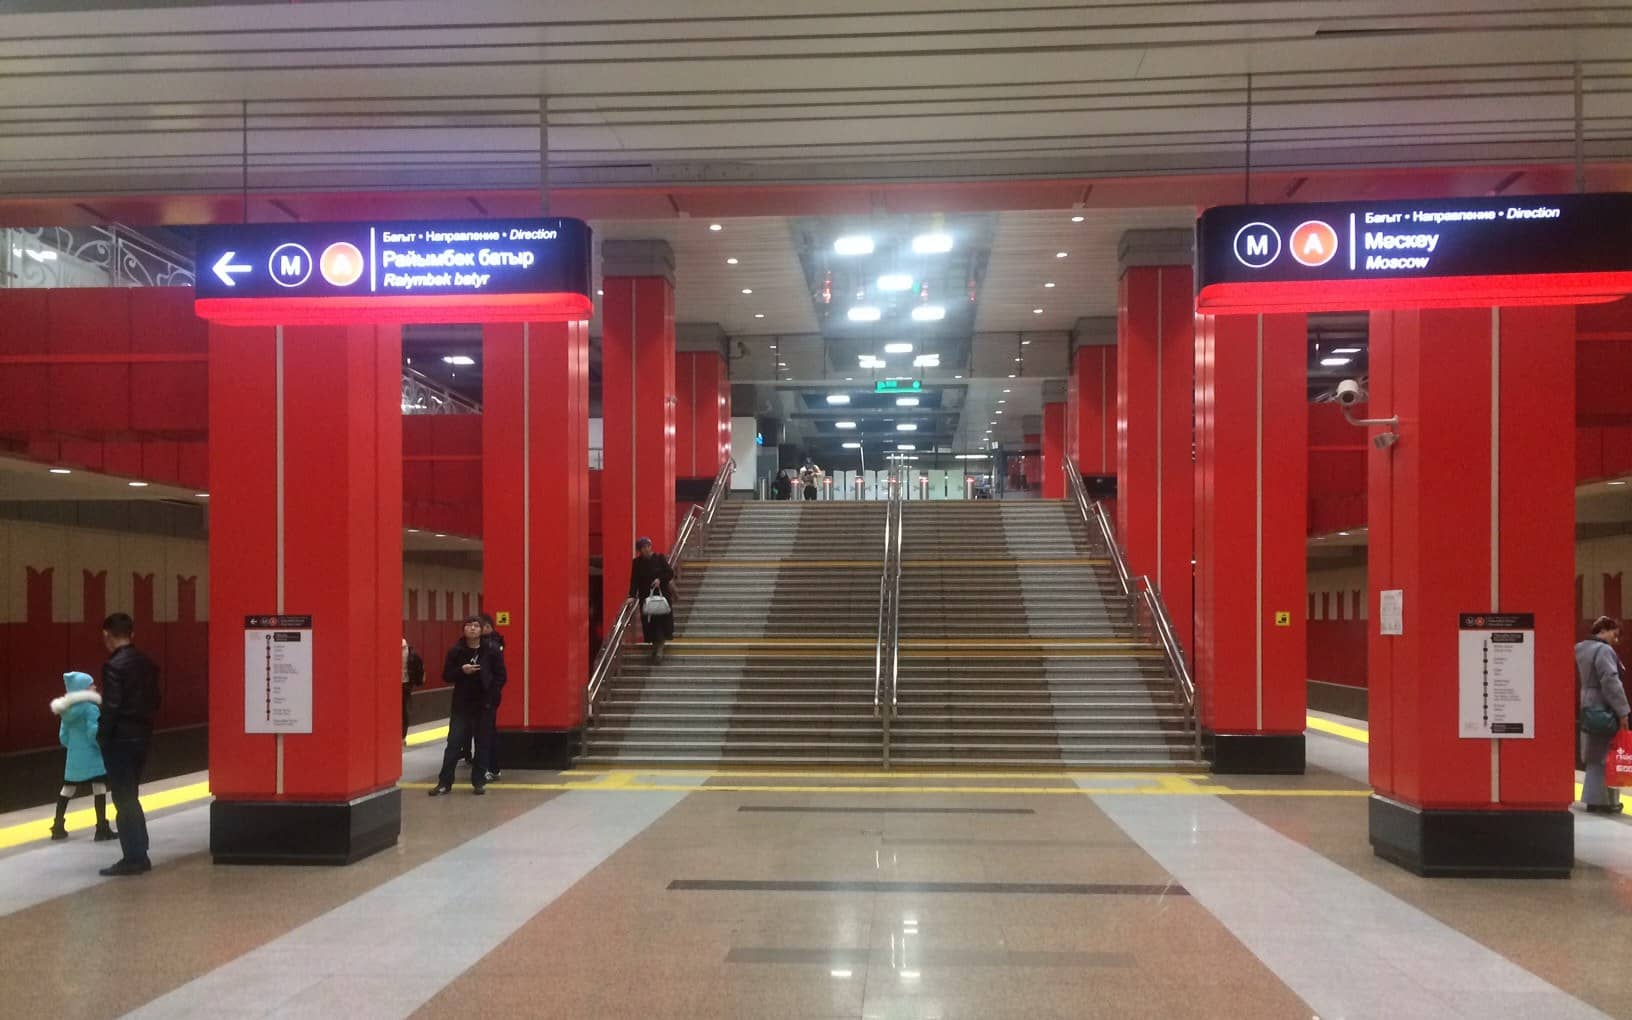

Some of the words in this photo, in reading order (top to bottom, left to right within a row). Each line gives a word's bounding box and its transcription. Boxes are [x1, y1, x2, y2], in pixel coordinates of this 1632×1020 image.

[1413, 211, 1495, 223] Направление
[1507, 207, 1560, 218] Direction
[425, 231, 499, 243] Направление
[510, 229, 557, 240] Direction
[1247, 234, 1268, 256] M
[1303, 233, 1324, 255] A
[281, 256, 300, 275] M
[333, 254, 354, 275] A
[383, 250, 475, 267] Райымбек
[478, 248, 534, 268] батыр
[1366, 256, 1429, 269] Moscow
[454, 272, 490, 288] batyr
